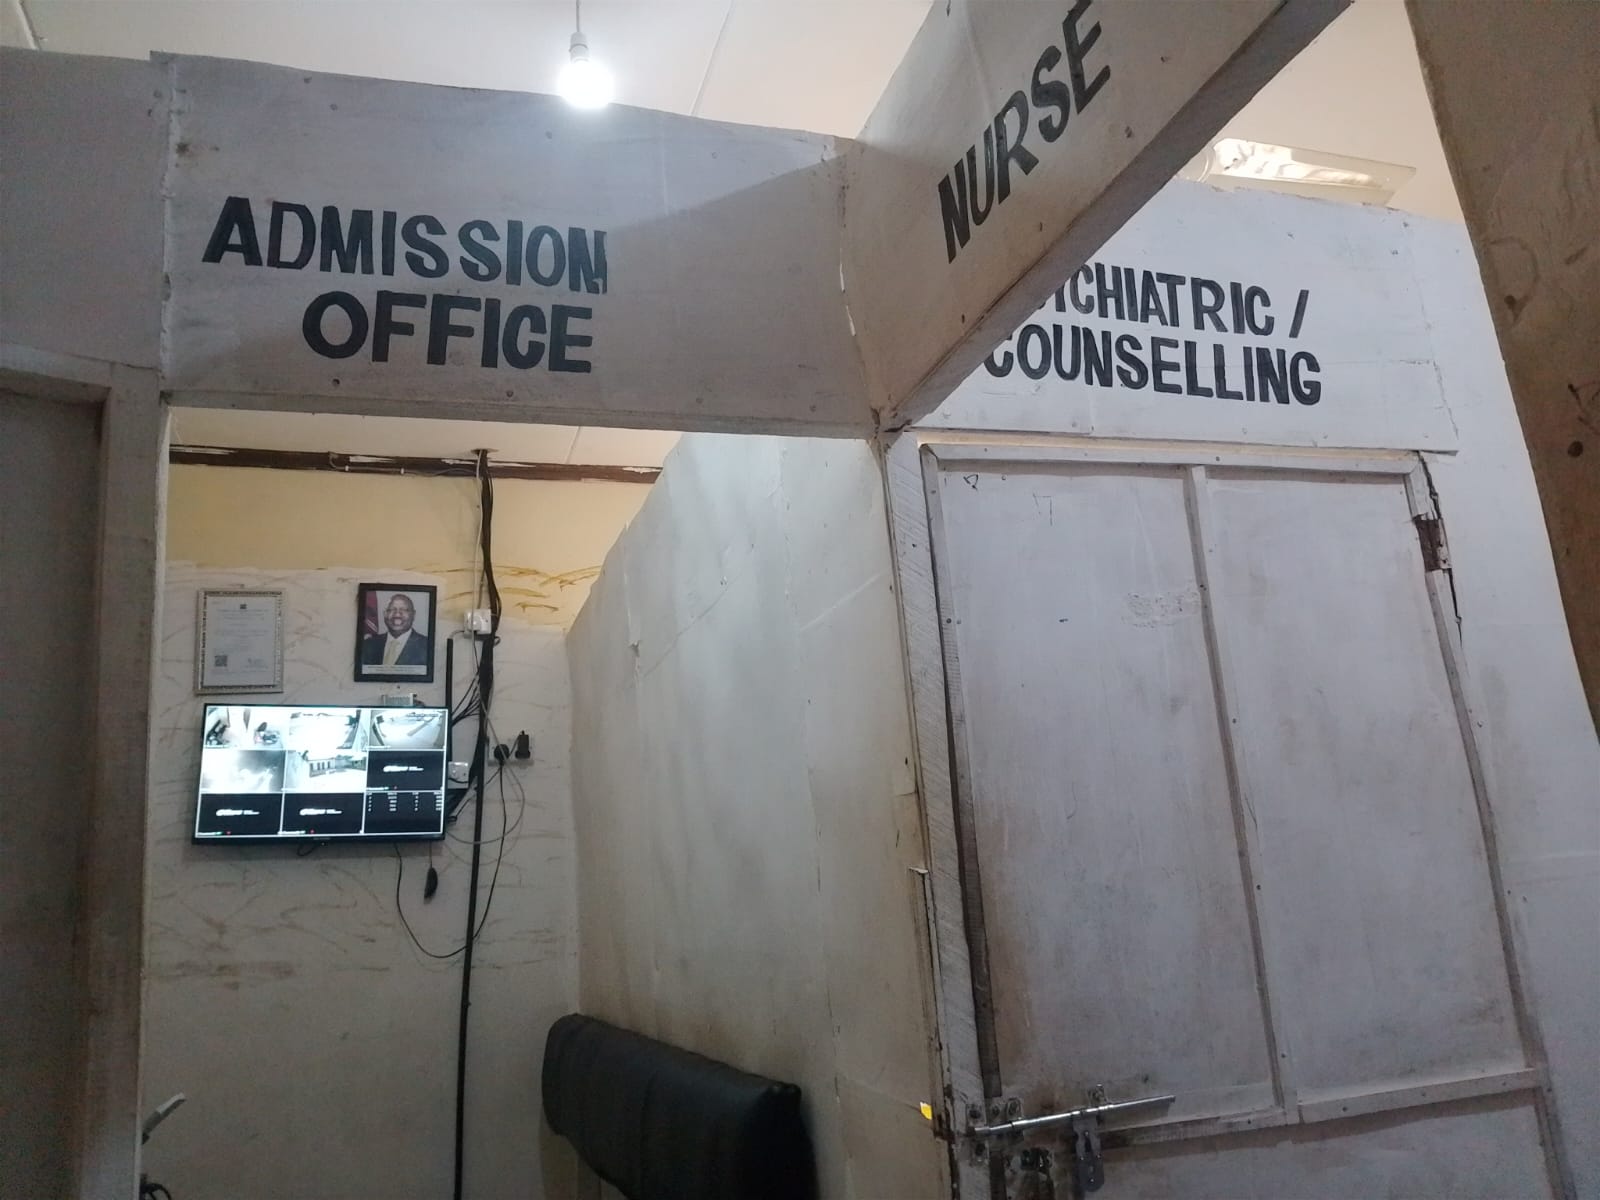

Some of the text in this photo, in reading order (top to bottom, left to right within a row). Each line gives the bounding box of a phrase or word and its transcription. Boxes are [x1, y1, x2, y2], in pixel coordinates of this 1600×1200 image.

[937, 0, 1111, 265] NURSE
[201, 195, 608, 295] ADMISSION
[302, 290, 593, 374] OFFICE
